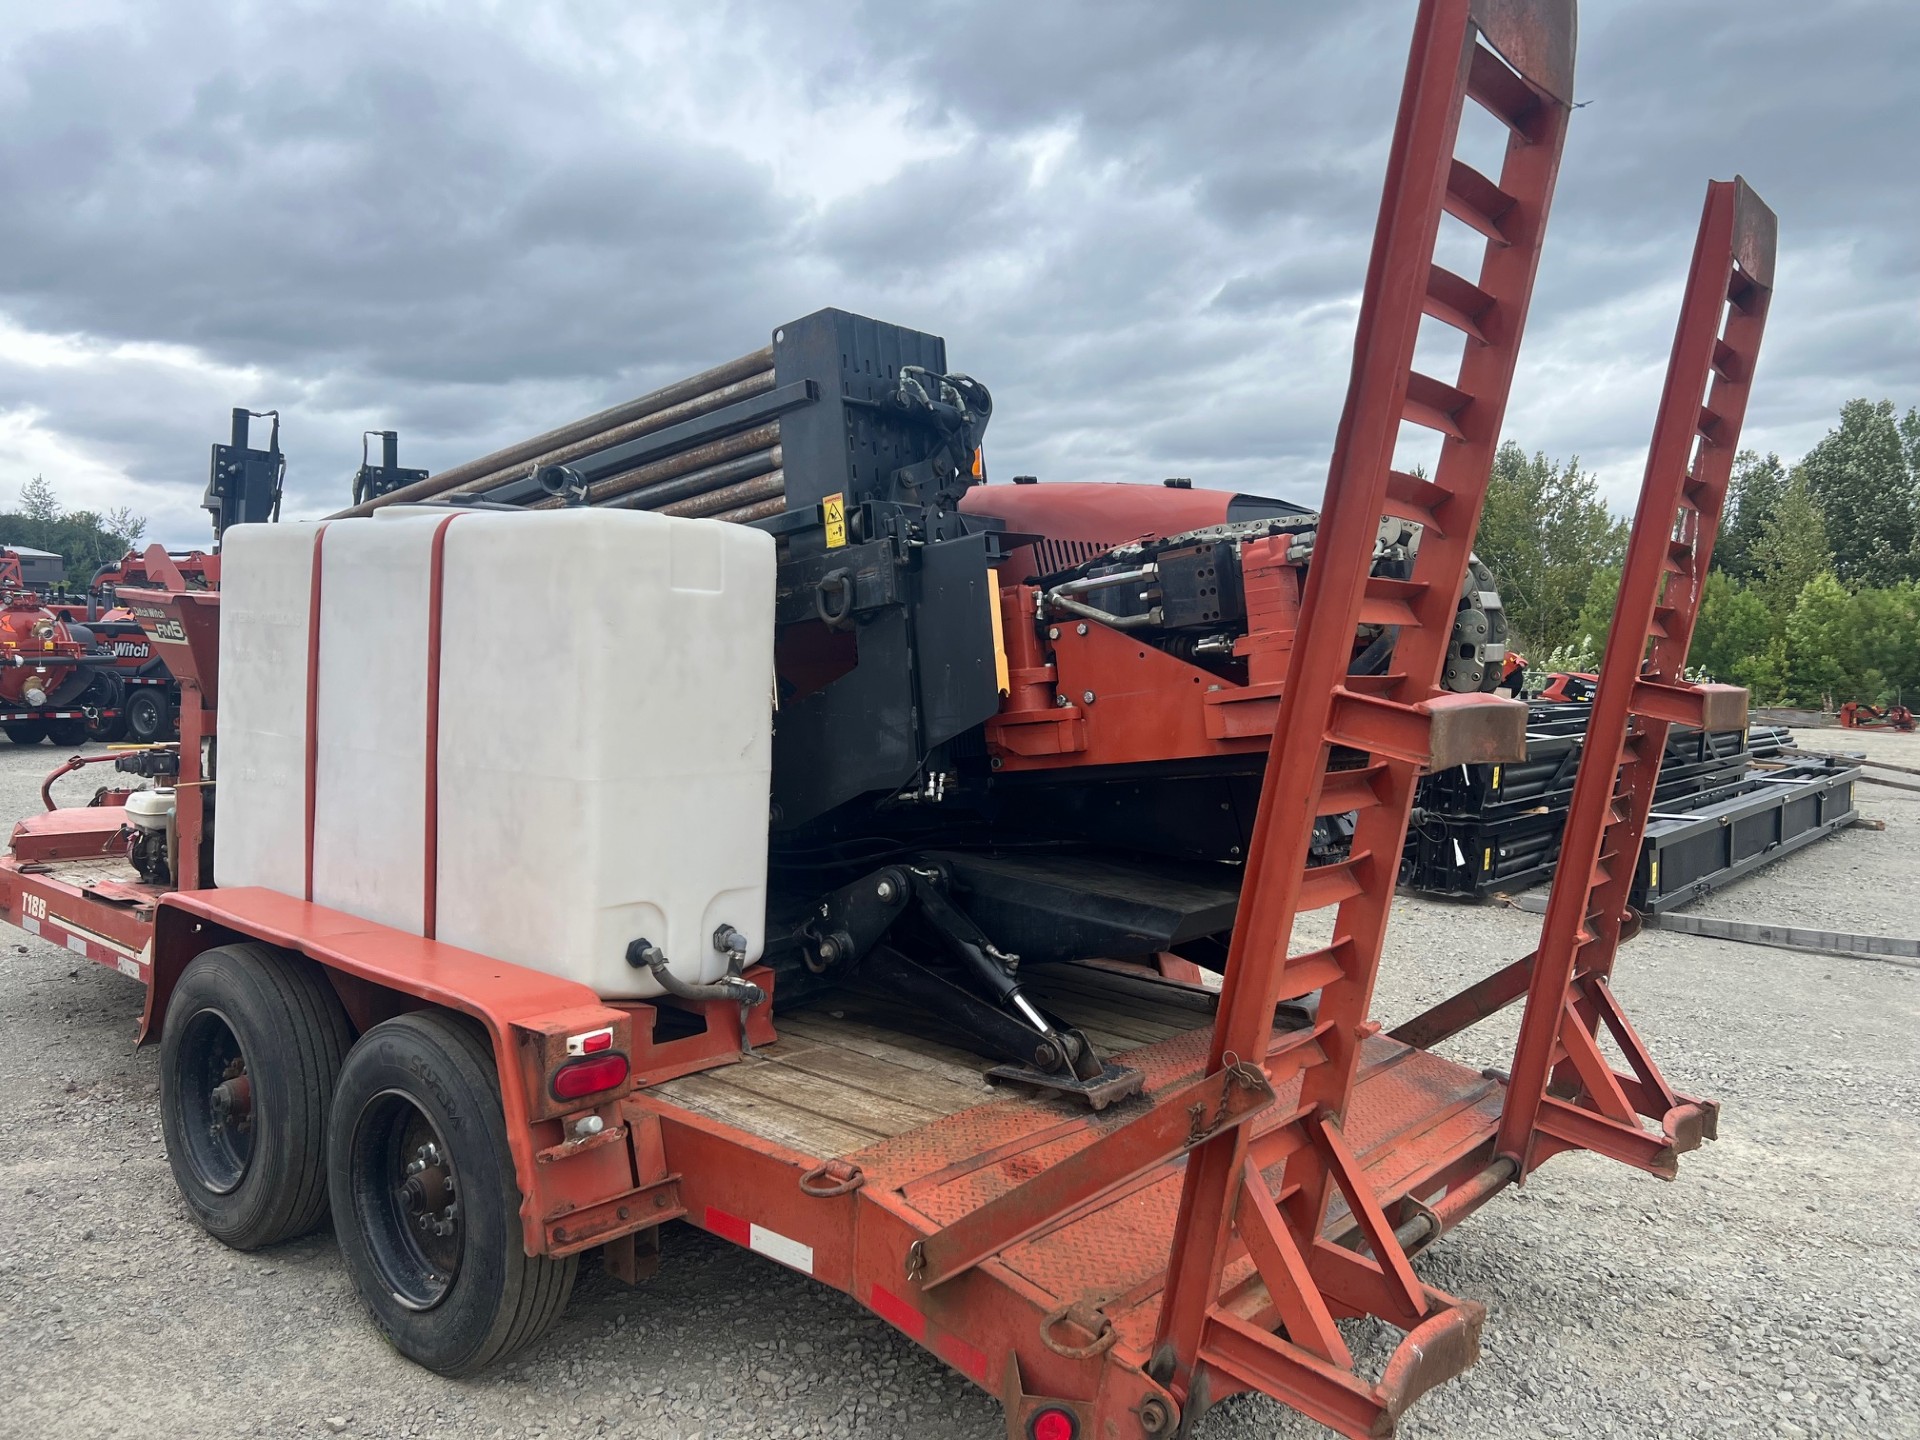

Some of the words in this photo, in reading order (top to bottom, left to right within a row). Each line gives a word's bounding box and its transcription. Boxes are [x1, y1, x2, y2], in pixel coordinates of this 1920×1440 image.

[147, 608, 166, 619] Witch
[155, 620, 184, 638] FM5
[114, 642, 149, 657] Witch
[22, 891, 47, 920] T18B
